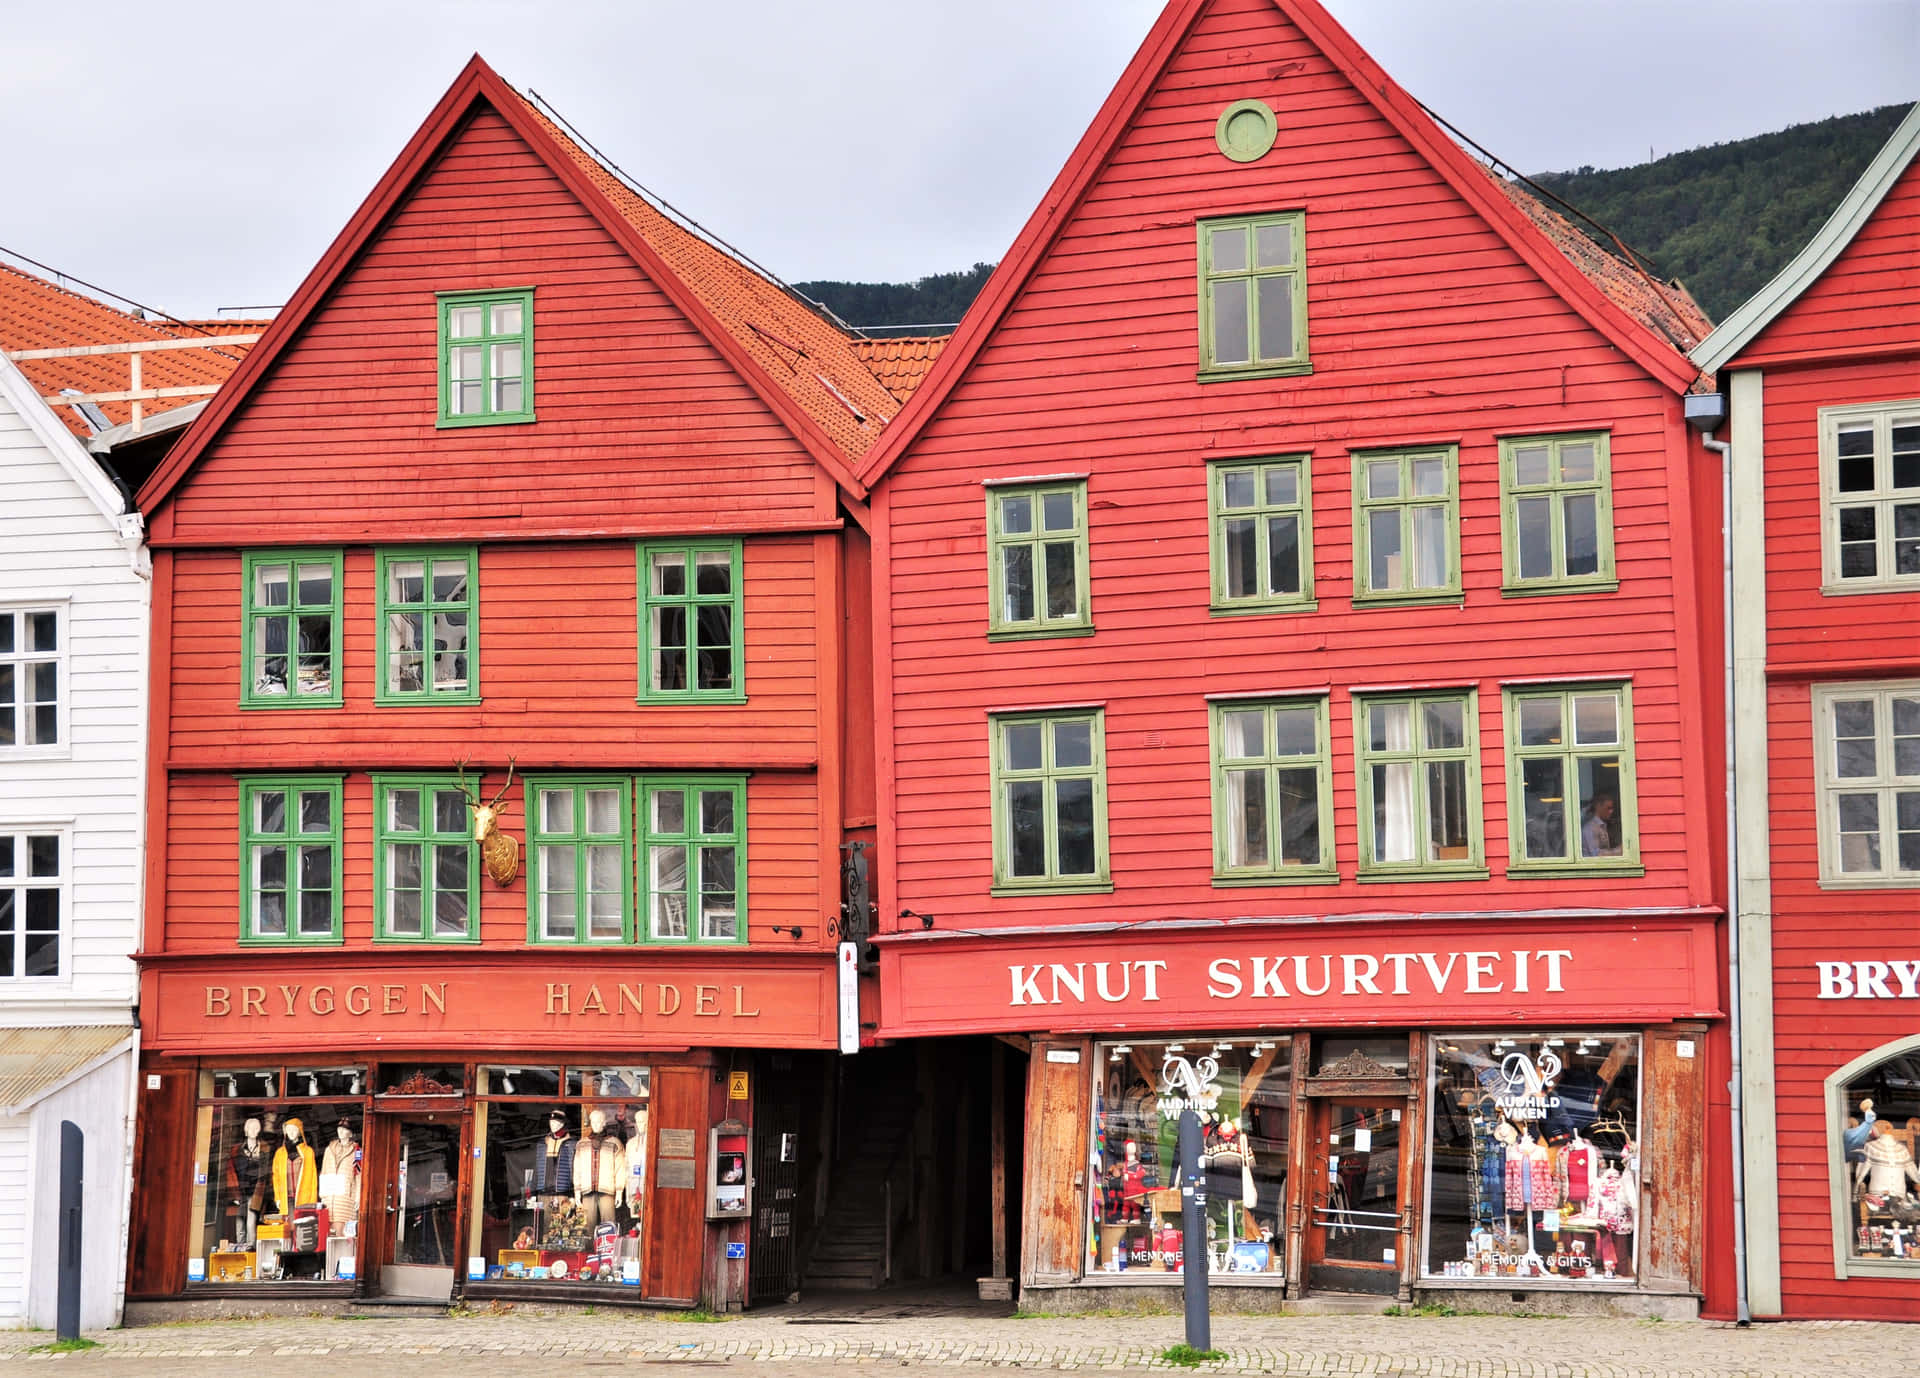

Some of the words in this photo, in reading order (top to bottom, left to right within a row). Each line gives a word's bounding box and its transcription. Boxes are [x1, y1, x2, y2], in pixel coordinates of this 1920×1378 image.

[1008, 960, 1168, 1006] KNUT
[1207, 949, 1574, 999] SKURTVEIT
[1815, 960, 1920, 998] BRY
[203, 982, 449, 1017] BRYGGEN
[544, 983, 761, 1017] HANDEL
[1156, 1098, 1218, 1110] AUDHILD
[1495, 1096, 1561, 1108] AUDHILD
[1503, 1107, 1547, 1119] VIKEN
[1558, 1256, 1592, 1268] GIFTS
